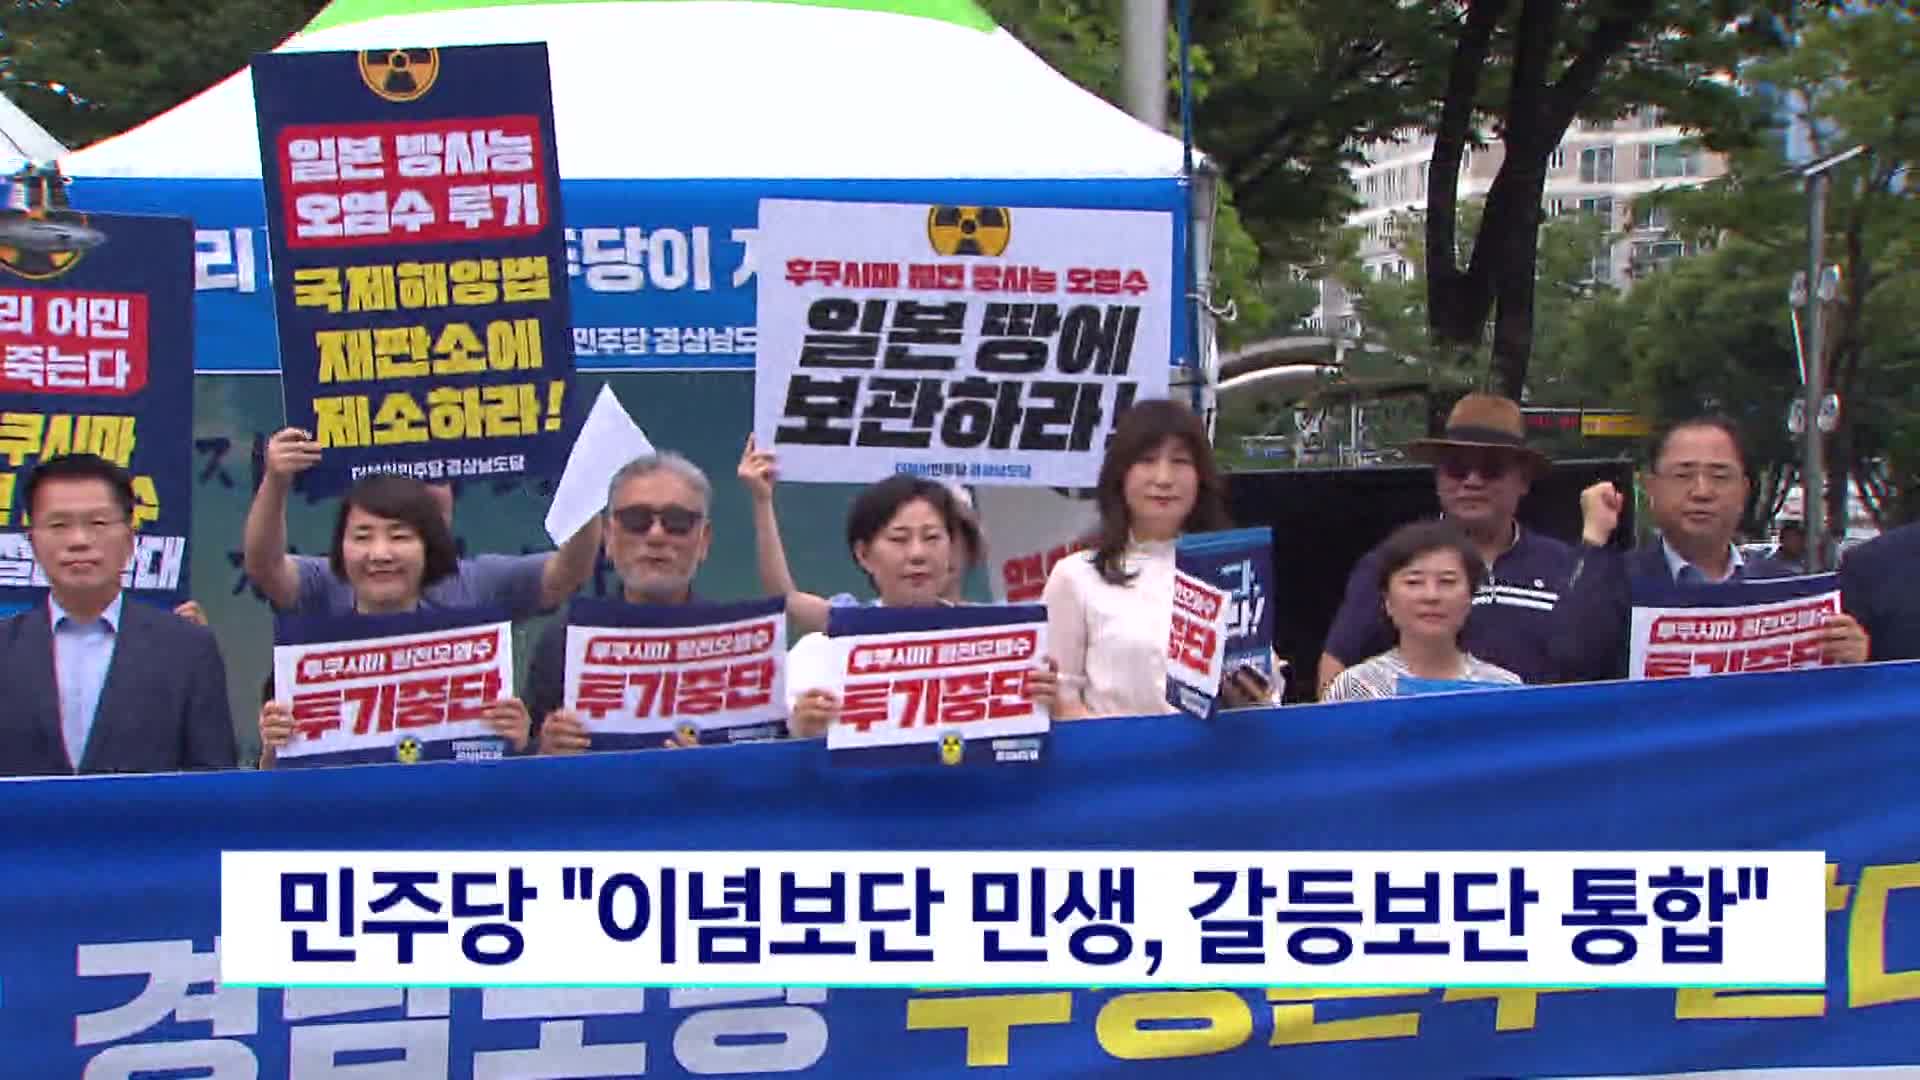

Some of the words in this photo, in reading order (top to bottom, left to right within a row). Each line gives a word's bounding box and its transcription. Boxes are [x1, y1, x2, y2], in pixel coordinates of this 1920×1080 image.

[288, 136, 384, 183] 일본
[395, 129, 533, 176] 방사능
[296, 189, 435, 238] 오염수
[448, 183, 539, 229] 투기
[294, 255, 550, 313] 국제해양법
[785, 258, 899, 288] 후쿠시마
[47, 297, 130, 339] 어민
[799, 298, 967, 371] 일본
[974, 302, 1141, 376] 땅에
[4, 344, 131, 390] 죽는다
[315, 318, 543, 384] 재판소에
[313, 379, 566, 449] 제소하라!
[292, 668, 502, 742] 투기중단
[575, 657, 774, 719] 투기중단
